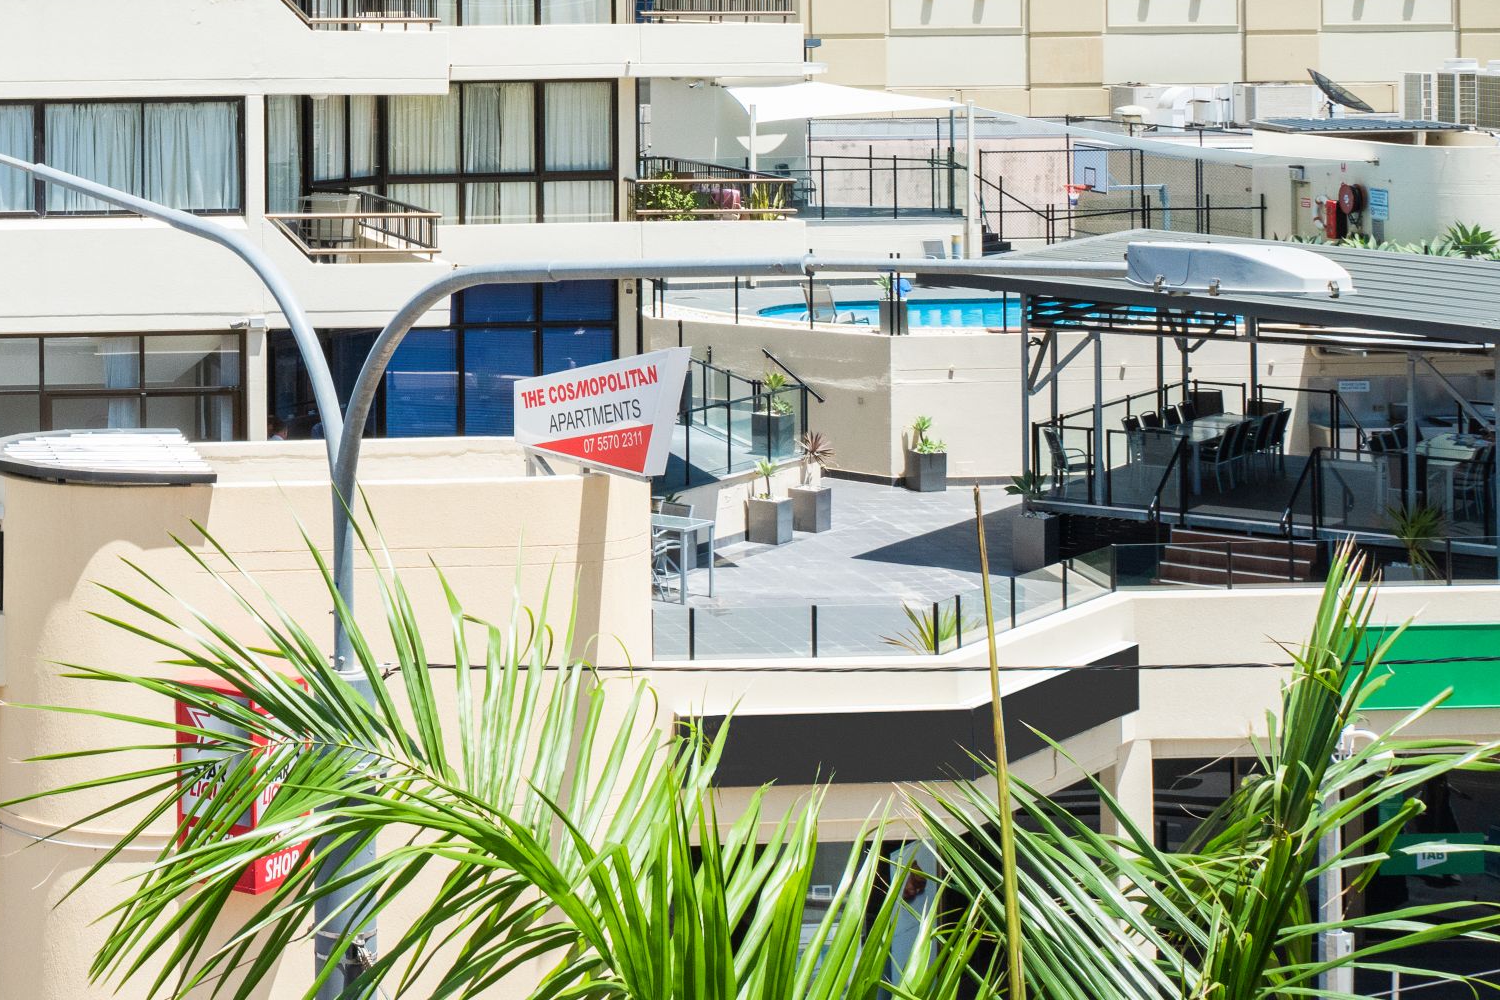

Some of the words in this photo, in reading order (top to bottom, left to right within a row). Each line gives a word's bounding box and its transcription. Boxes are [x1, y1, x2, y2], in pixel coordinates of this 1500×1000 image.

[521, 389, 546, 409] THE
[549, 364, 658, 404] COSMOPOLITAN
[550, 399, 642, 433] APARTMENTS
[584, 438, 595, 454] 07
[597, 434, 620, 451] 5570
[622, 431, 643, 448] 2311
[265, 849, 300, 883] SHOP
